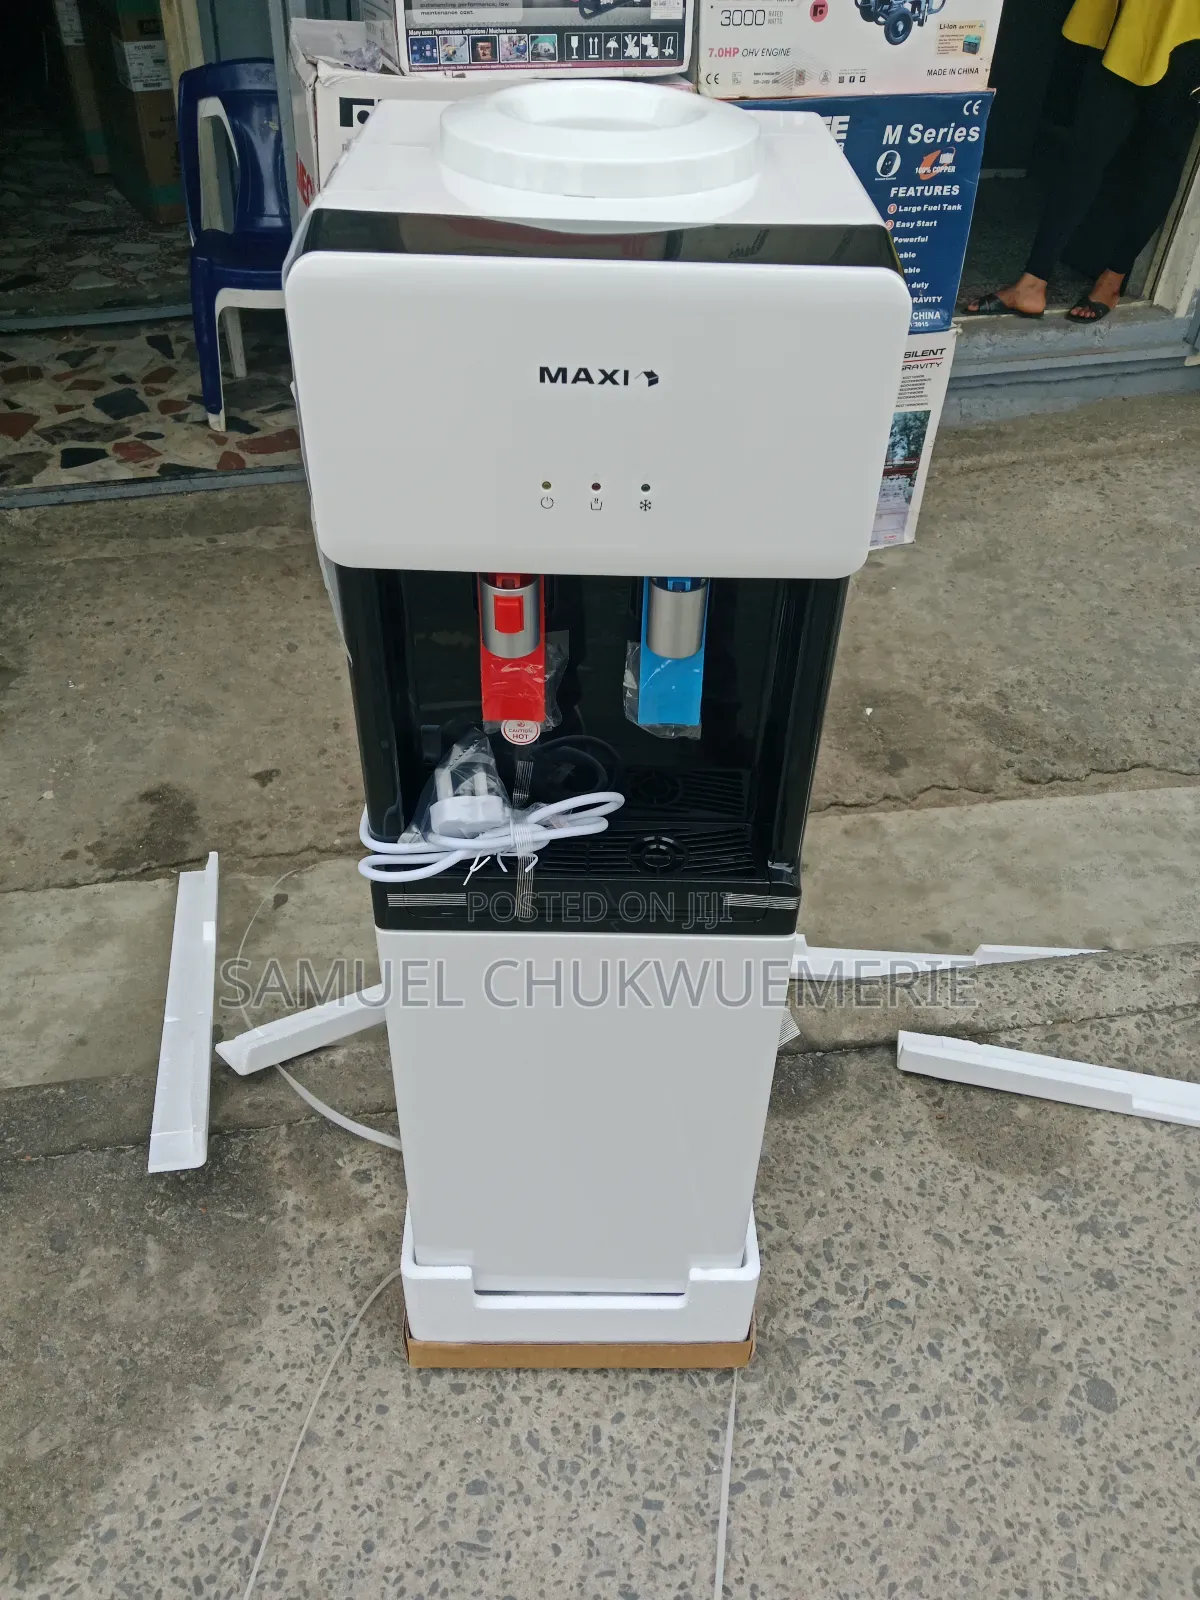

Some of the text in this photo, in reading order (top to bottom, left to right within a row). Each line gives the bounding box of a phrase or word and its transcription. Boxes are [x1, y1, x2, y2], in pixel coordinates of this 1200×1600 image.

[720, 9, 766, 26] 3000
[708, 47, 791, 58] 7.0HP OHV ENGINE
[926, 67, 979, 77] MADE IN CHINA
[882, 122, 980, 144] M Series
[932, 165, 956, 173] COPPER
[890, 184, 960, 198] FEATURES
[898, 205, 922, 213] Large
[942, 203, 963, 211] Tank
[895, 220, 915, 228] Easy
[893, 235, 929, 243] Powerful
[898, 251, 917, 259] able
[911, 282, 929, 290] duty
[911, 296, 943, 304] RAVITY
[912, 311, 941, 320] CHINA
[903, 348, 947, 359] SILENT
[539, 366, 629, 386] MAXI
